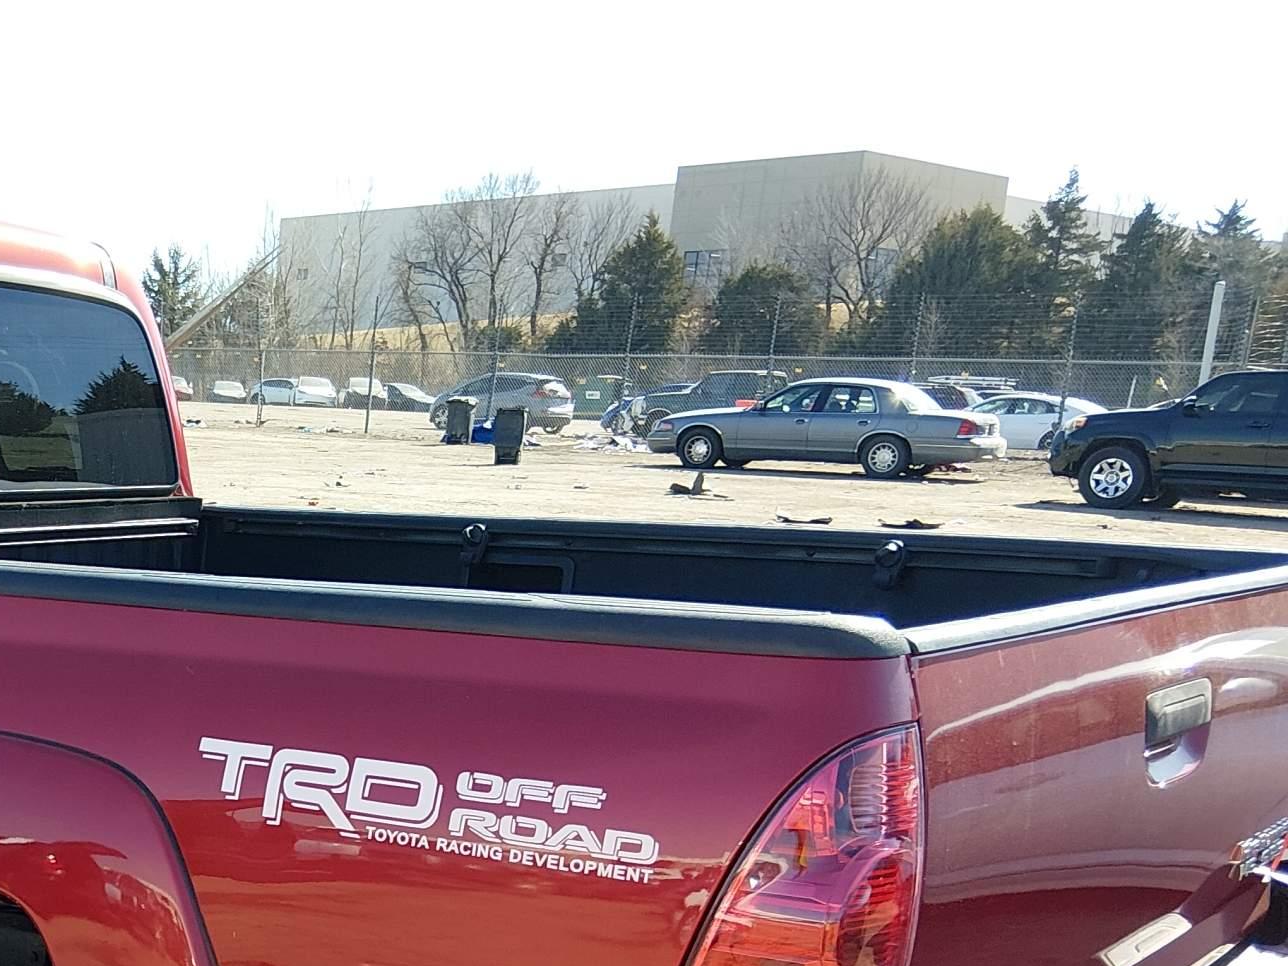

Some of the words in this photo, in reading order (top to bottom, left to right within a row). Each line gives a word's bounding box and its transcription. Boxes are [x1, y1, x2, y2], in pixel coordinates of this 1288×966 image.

[198, 736, 443, 839] TRD
[455, 771, 608, 814] OFF
[365, 825, 429, 849] TOYOTA
[436, 838, 503, 862] RACING
[508, 848, 654, 884] DEVELOPMENT
[448, 808, 659, 865] ROAD
